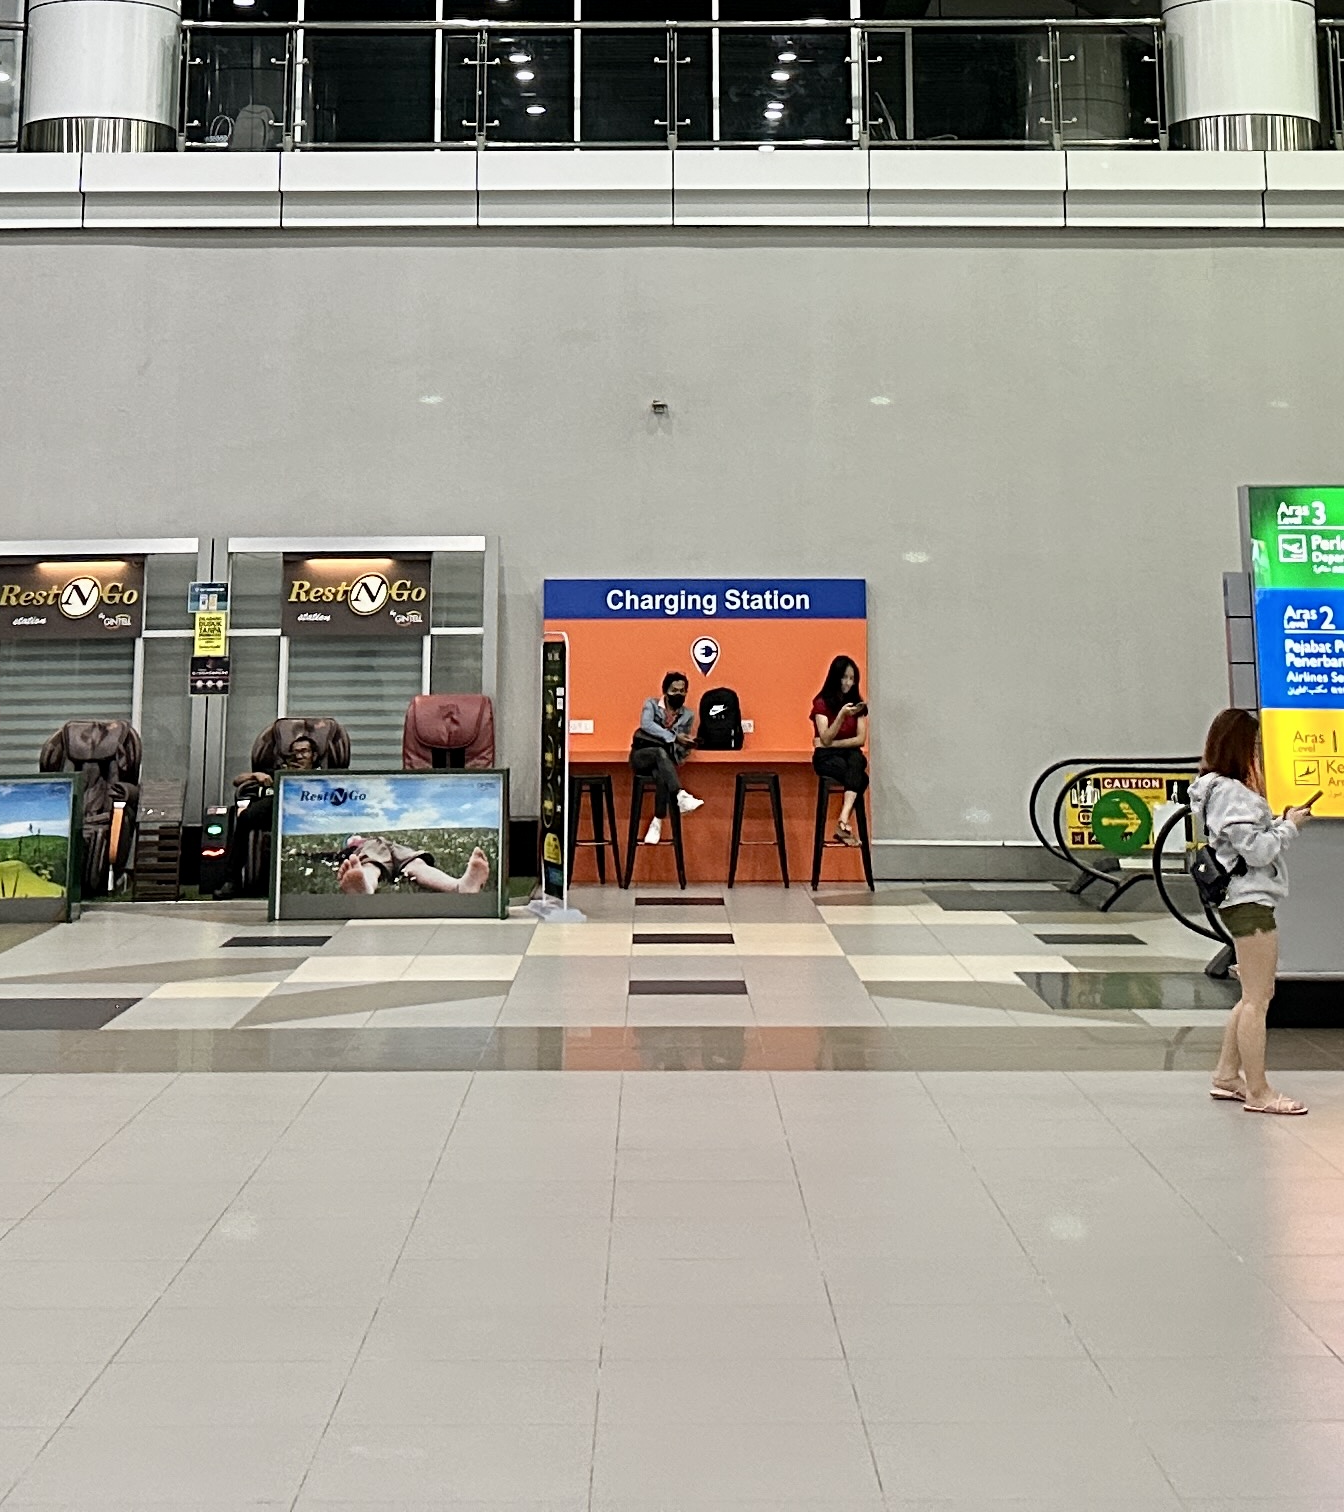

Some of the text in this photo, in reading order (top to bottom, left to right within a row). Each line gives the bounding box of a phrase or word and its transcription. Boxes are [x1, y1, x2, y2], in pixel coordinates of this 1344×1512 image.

[1277, 500, 1327, 525] Aras 3
[101, 582, 139, 605] Go
[288, 580, 350, 602] Rest
[390, 579, 427, 602] Go
[606, 589, 810, 615] Charging Station
[1284, 605, 1336, 630] Aras 2
[1285, 639, 1332, 656] Pejabat
[1286, 671, 1328, 683] Airlines
[1293, 730, 1325, 744] Aras
[1104, 778, 1160, 788] CAUTION
[300, 790, 329, 802] Rest
[348, 790, 367, 801] Go
